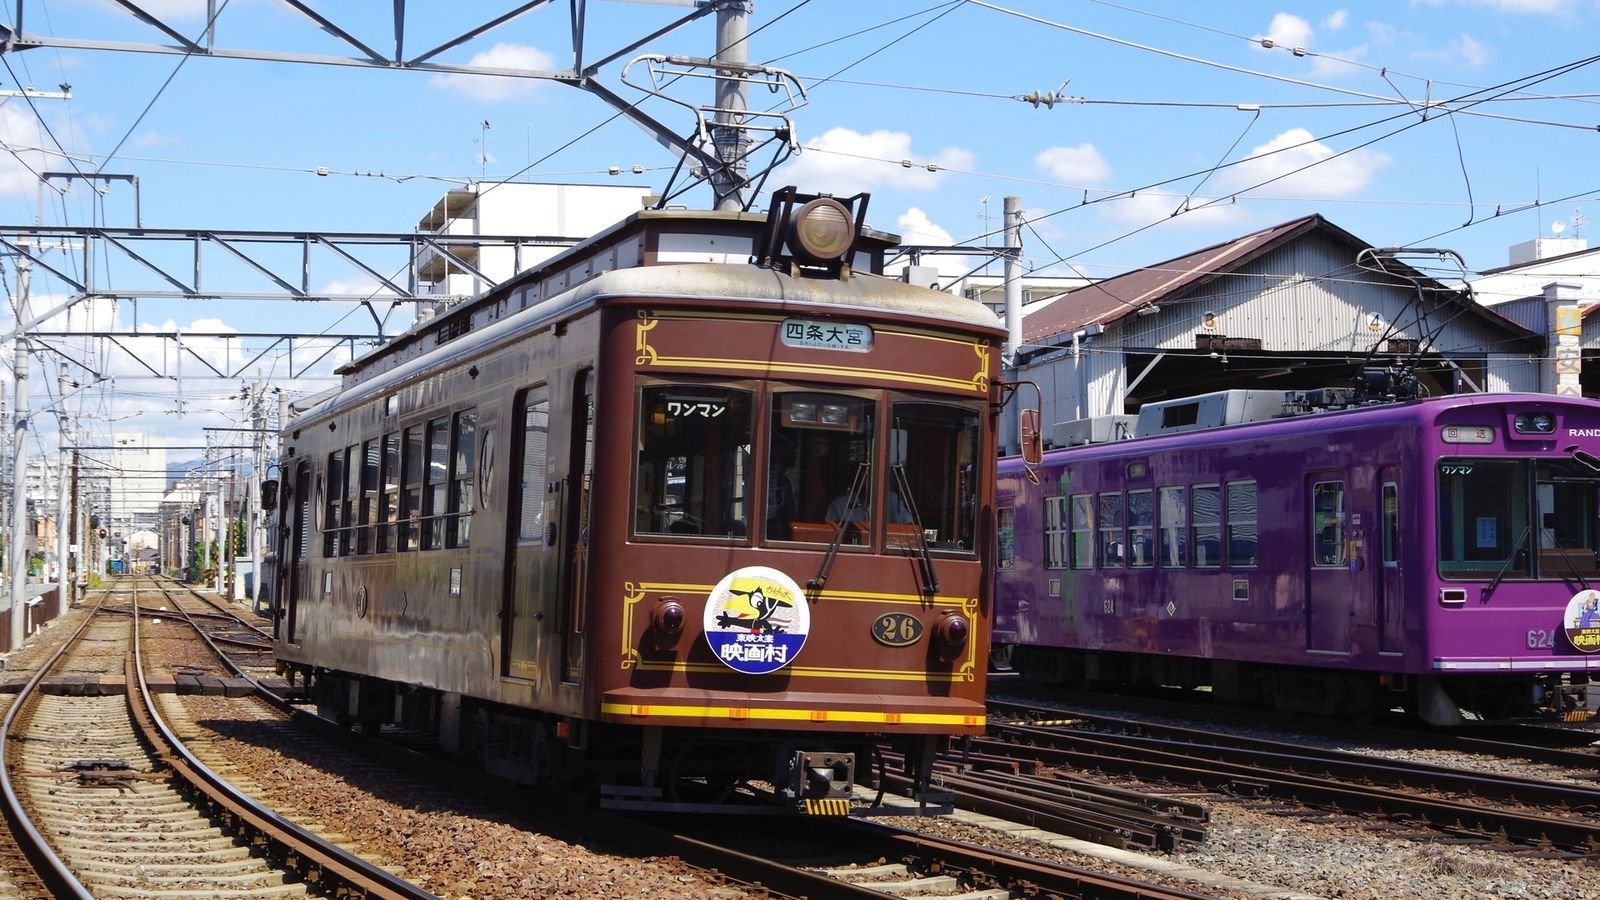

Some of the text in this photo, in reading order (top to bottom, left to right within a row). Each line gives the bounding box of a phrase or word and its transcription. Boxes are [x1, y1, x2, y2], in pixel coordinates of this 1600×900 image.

[1370, 314, 1379, 327] 4
[786, 323, 864, 345] 四条大宮
[667, 402, 726, 418] ワンマン
[1448, 428, 1487, 439] 回送
[1569, 428, 1600, 437] RAND
[1442, 465, 1473, 475] ワンマン
[1103, 599, 1114, 614] 624
[882, 616, 914, 640] 26
[1527, 629, 1556, 648] 624
[720, 643, 788, 663] 映画村
